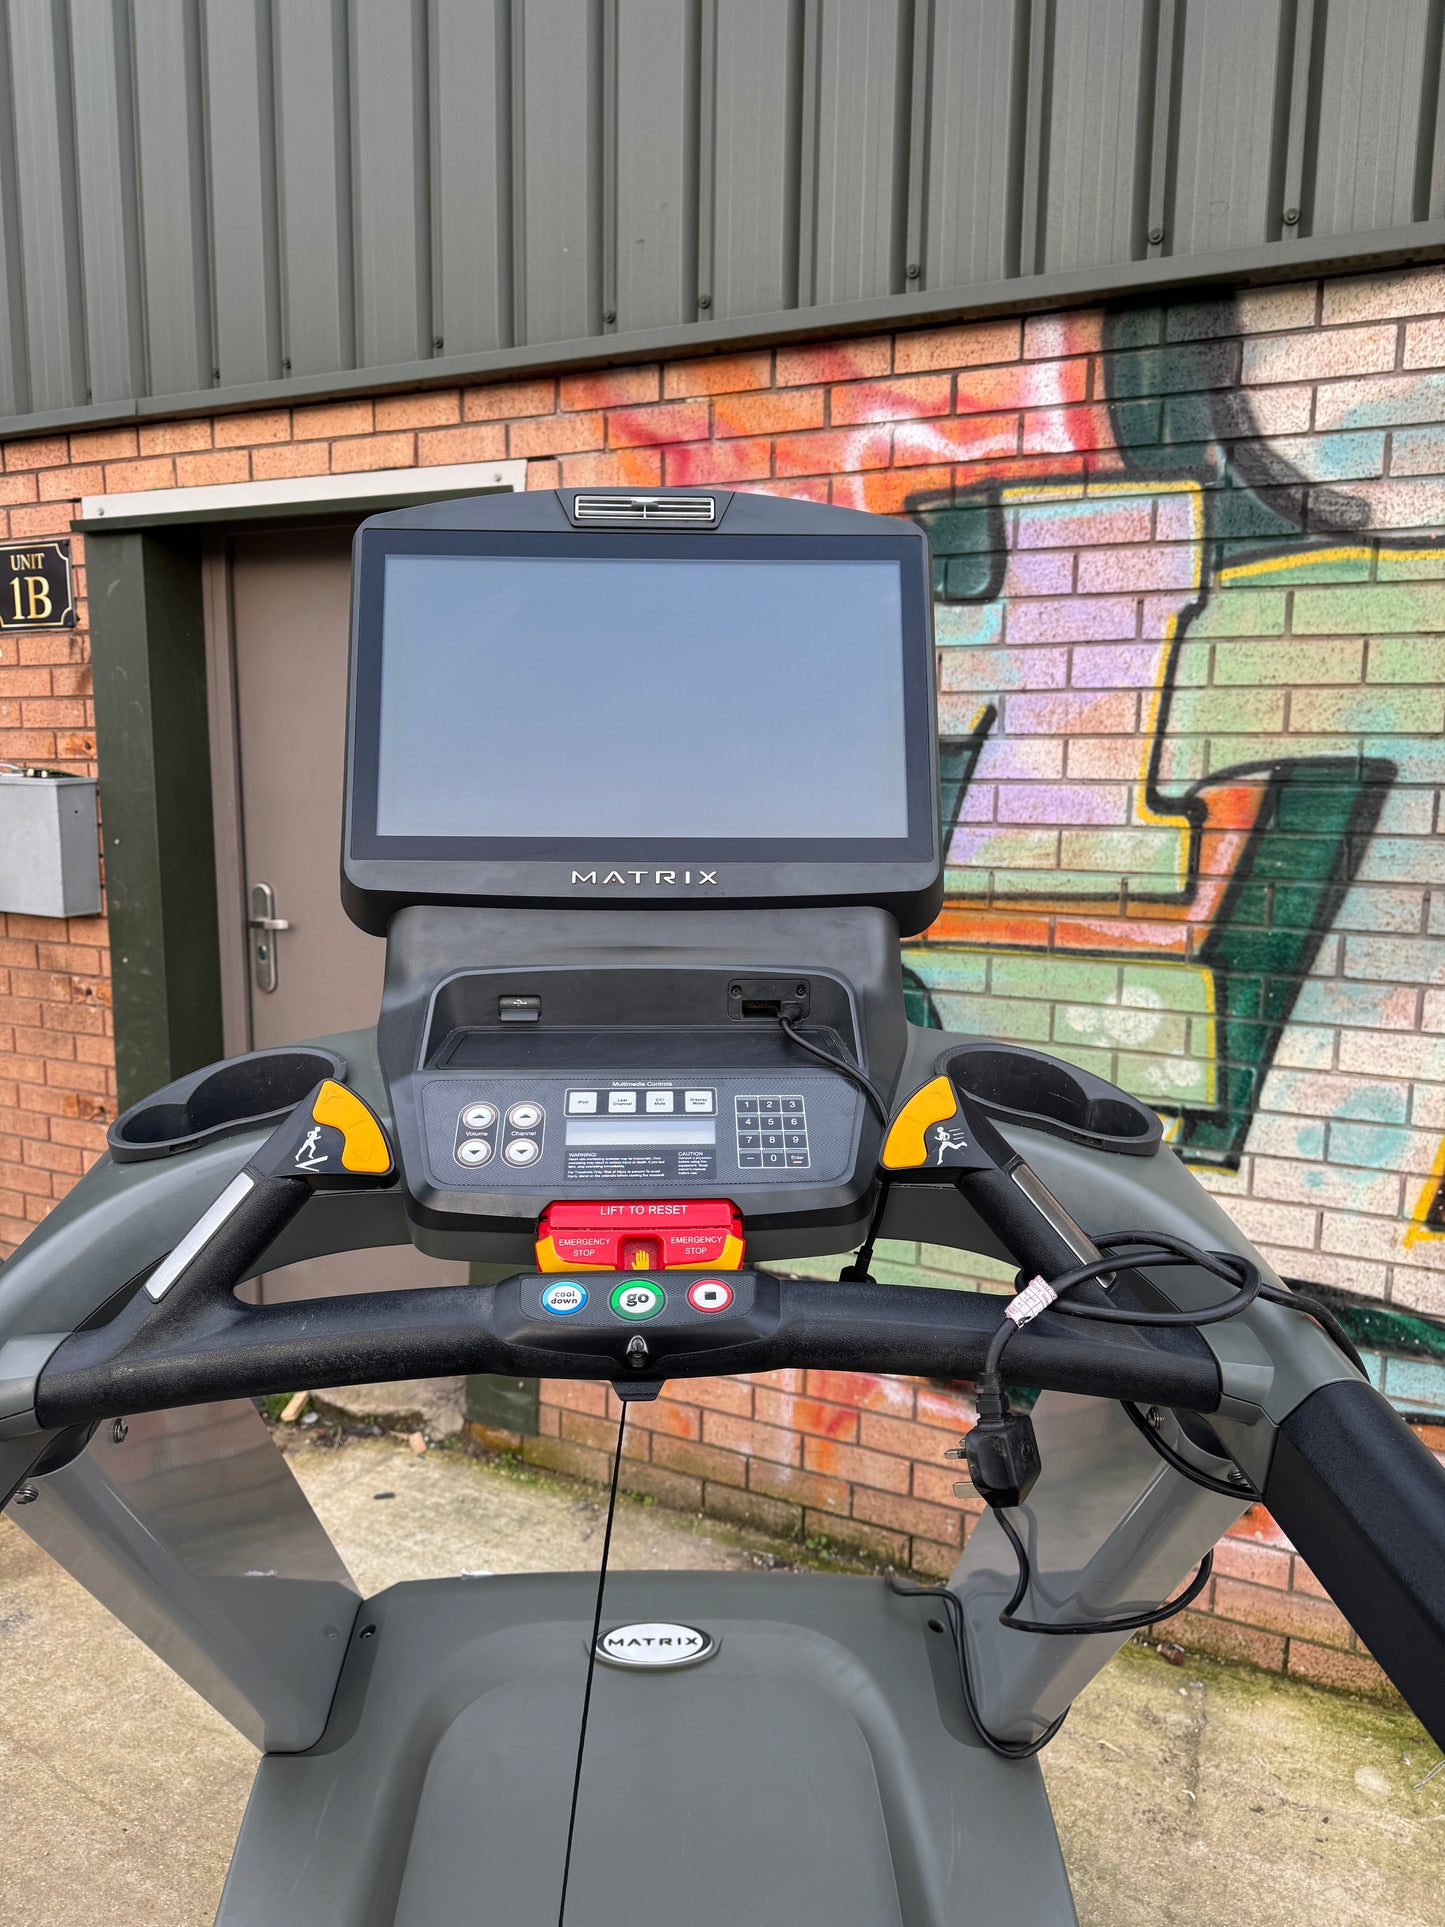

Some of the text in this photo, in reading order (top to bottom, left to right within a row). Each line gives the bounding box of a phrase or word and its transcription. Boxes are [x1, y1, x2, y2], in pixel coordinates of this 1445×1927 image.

[10, 552, 45, 571] UNIT
[9, 575, 53, 620] 1B
[571, 870, 718, 885] MATRIX
[745, 1118, 751, 1126] 4
[768, 1118, 774, 1126] 5
[791, 1118, 798, 1126] 6
[746, 1136, 752, 1144] 7
[769, 1136, 776, 1144] 8
[792, 1136, 799, 1144] 9
[770, 1154, 777, 1162] 0
[600, 1204, 688, 1216] LIFT TO RESET
[558, 1237, 611, 1247] EMERGENCY
[670, 1235, 722, 1244] EMERGENCY
[573, 1249, 596, 1257] STOP
[685, 1247, 707, 1255] STOP
[550, 1296, 578, 1305] down
[626, 1293, 650, 1308] go
[608, 1637, 698, 1647] MATRIX
